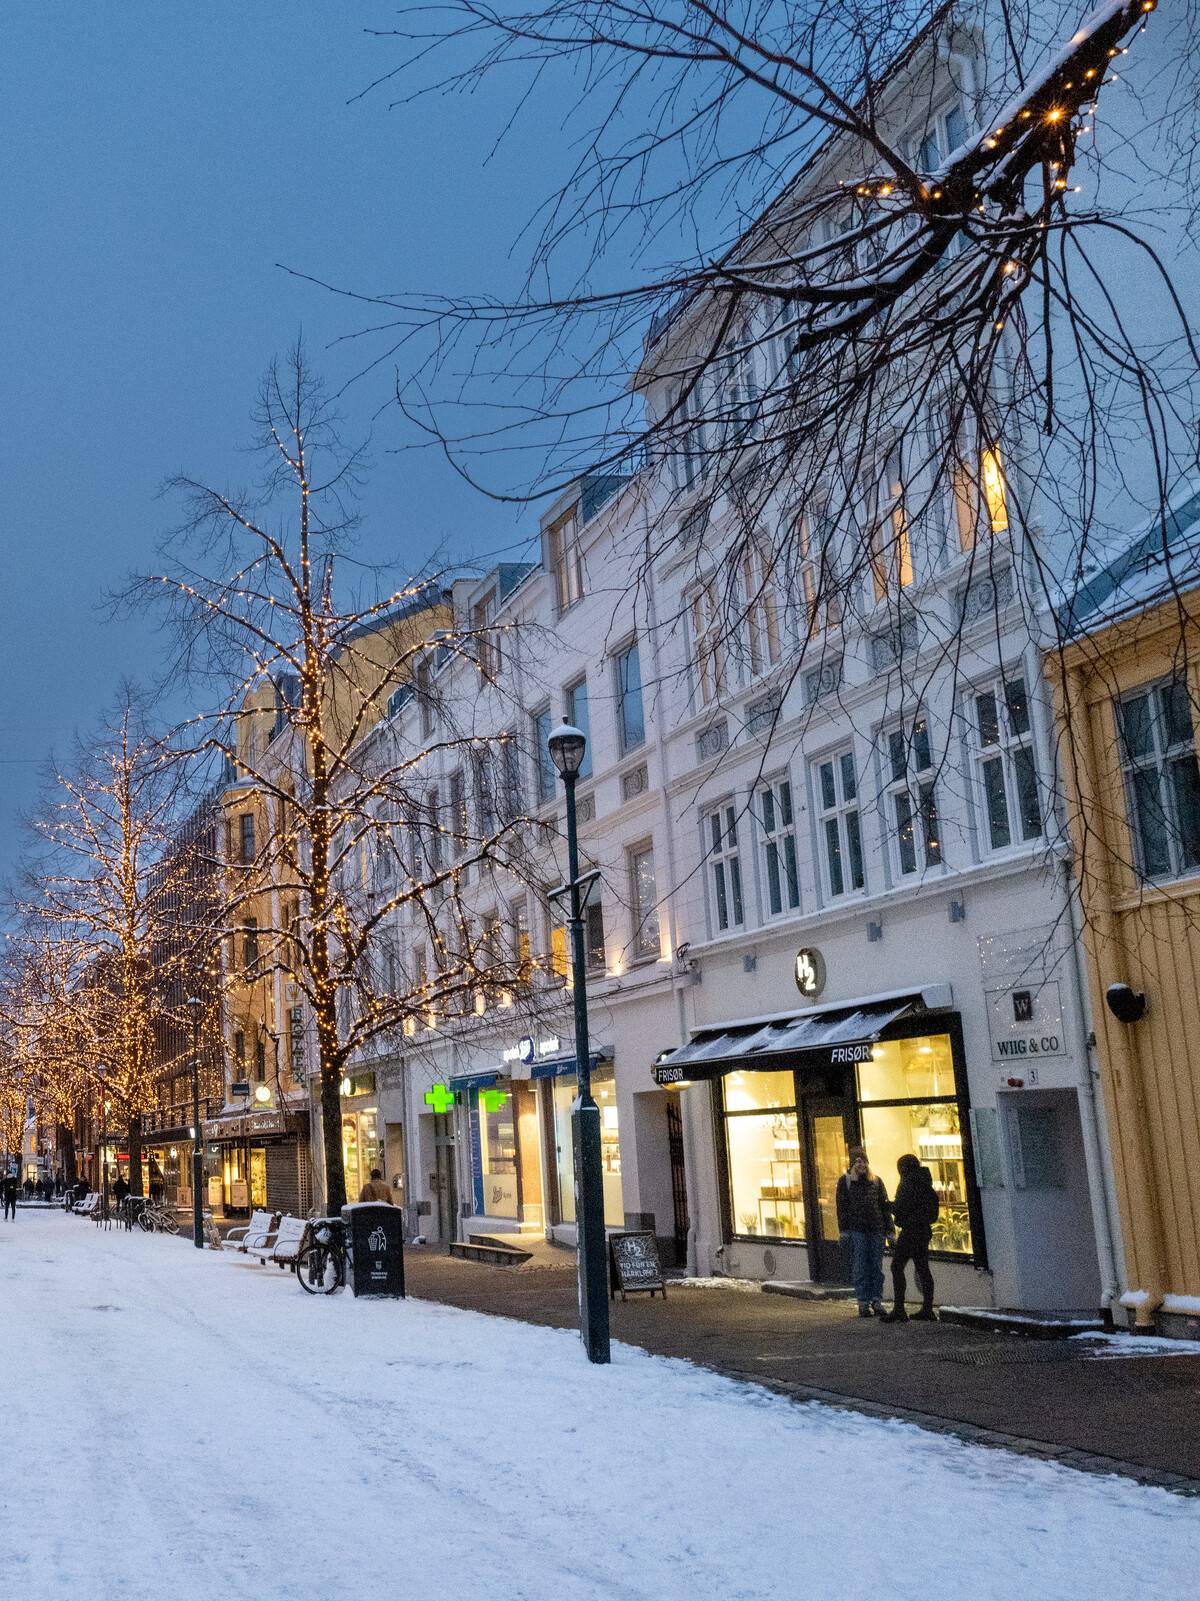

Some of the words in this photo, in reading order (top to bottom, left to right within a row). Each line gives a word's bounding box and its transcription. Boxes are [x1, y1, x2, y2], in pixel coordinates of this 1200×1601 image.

[292, 1007, 305, 1084] ROLEX
[831, 1045, 870, 1063] FRISØR
[997, 1038, 1027, 1056] WIIG
[1028, 1038, 1039, 1053] &
[1040, 1036, 1059, 1051] CO
[658, 1068, 684, 1082] FRISØR
[1030, 1071, 1037, 1082] 3
